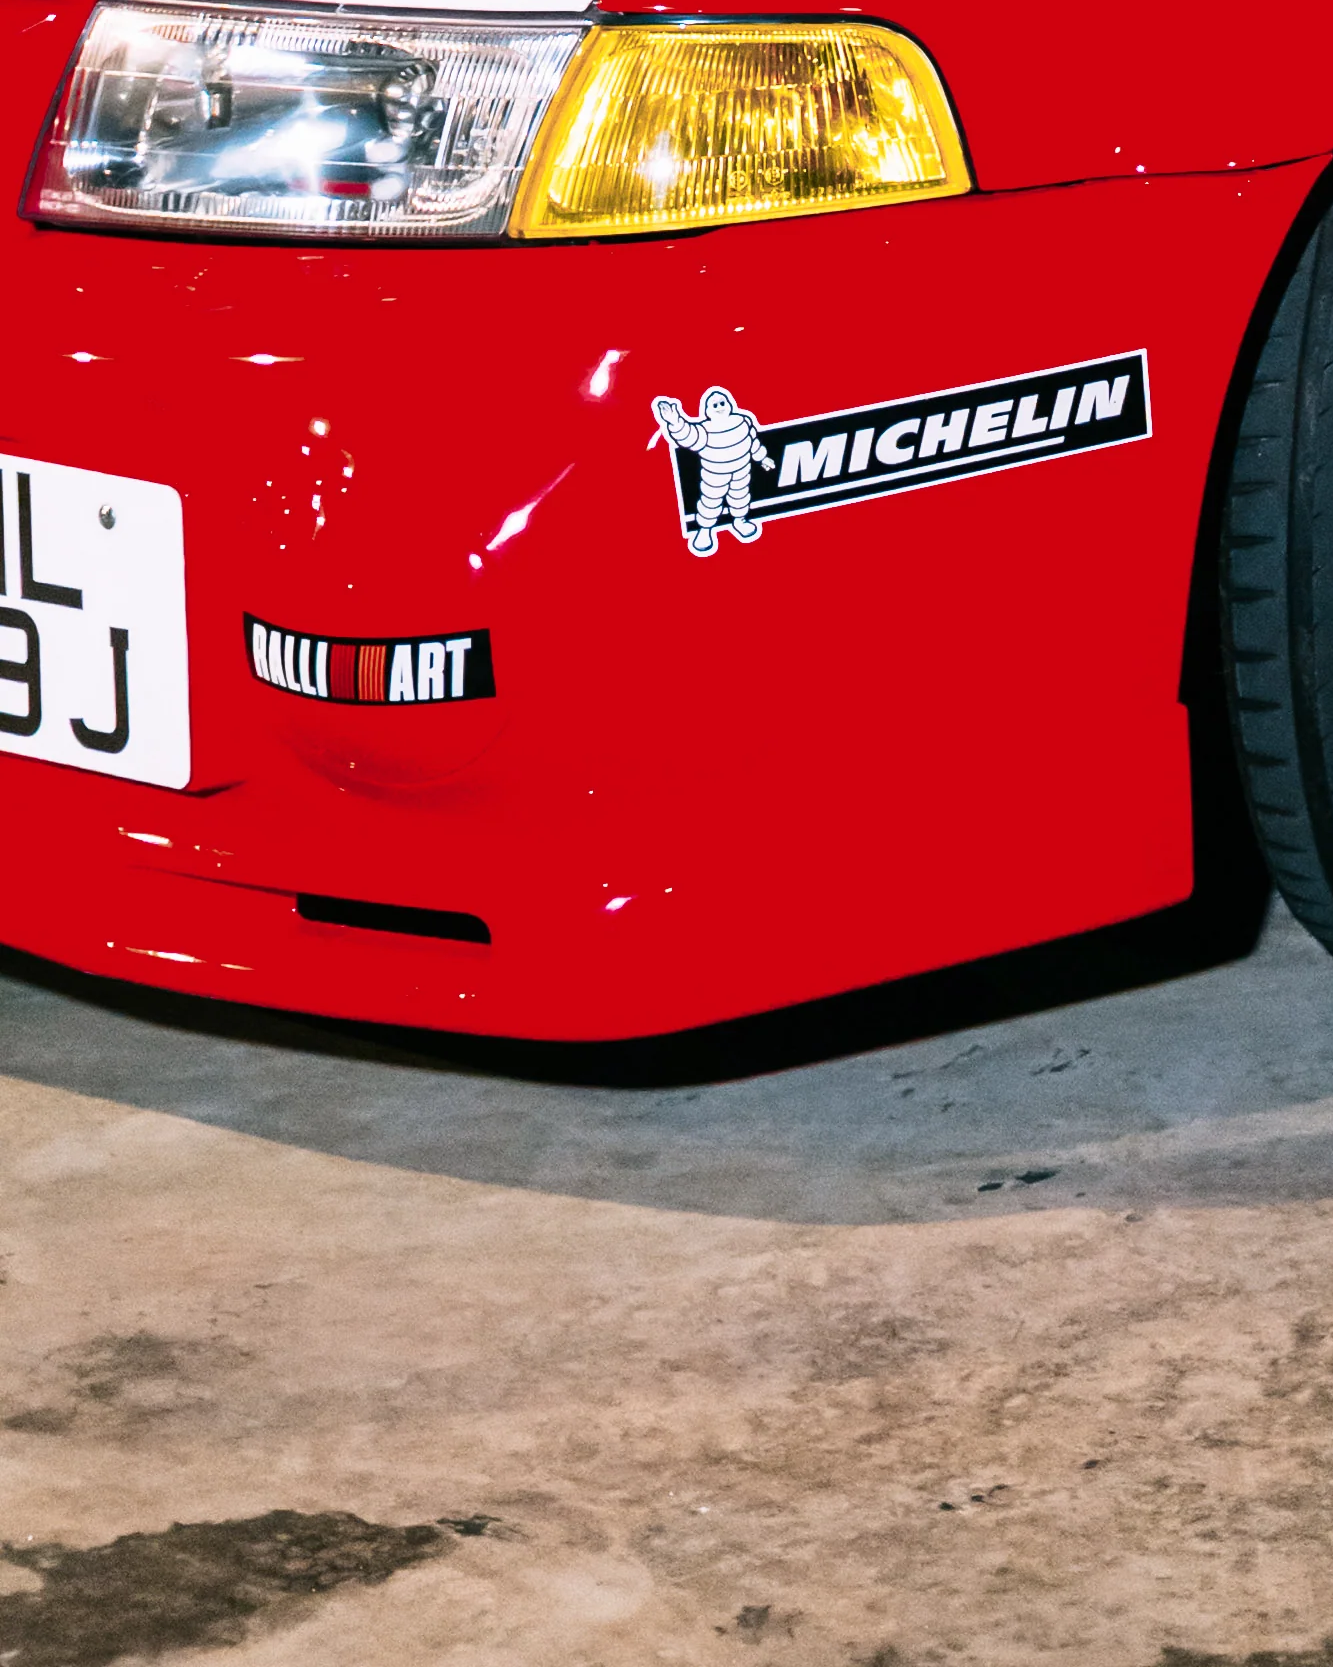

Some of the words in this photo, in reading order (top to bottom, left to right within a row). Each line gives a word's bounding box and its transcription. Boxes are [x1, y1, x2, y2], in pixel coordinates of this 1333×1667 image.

[777, 373, 1132, 489] MICHELIN
[251, 622, 329, 699] RALLI
[388, 637, 472, 703] ART
